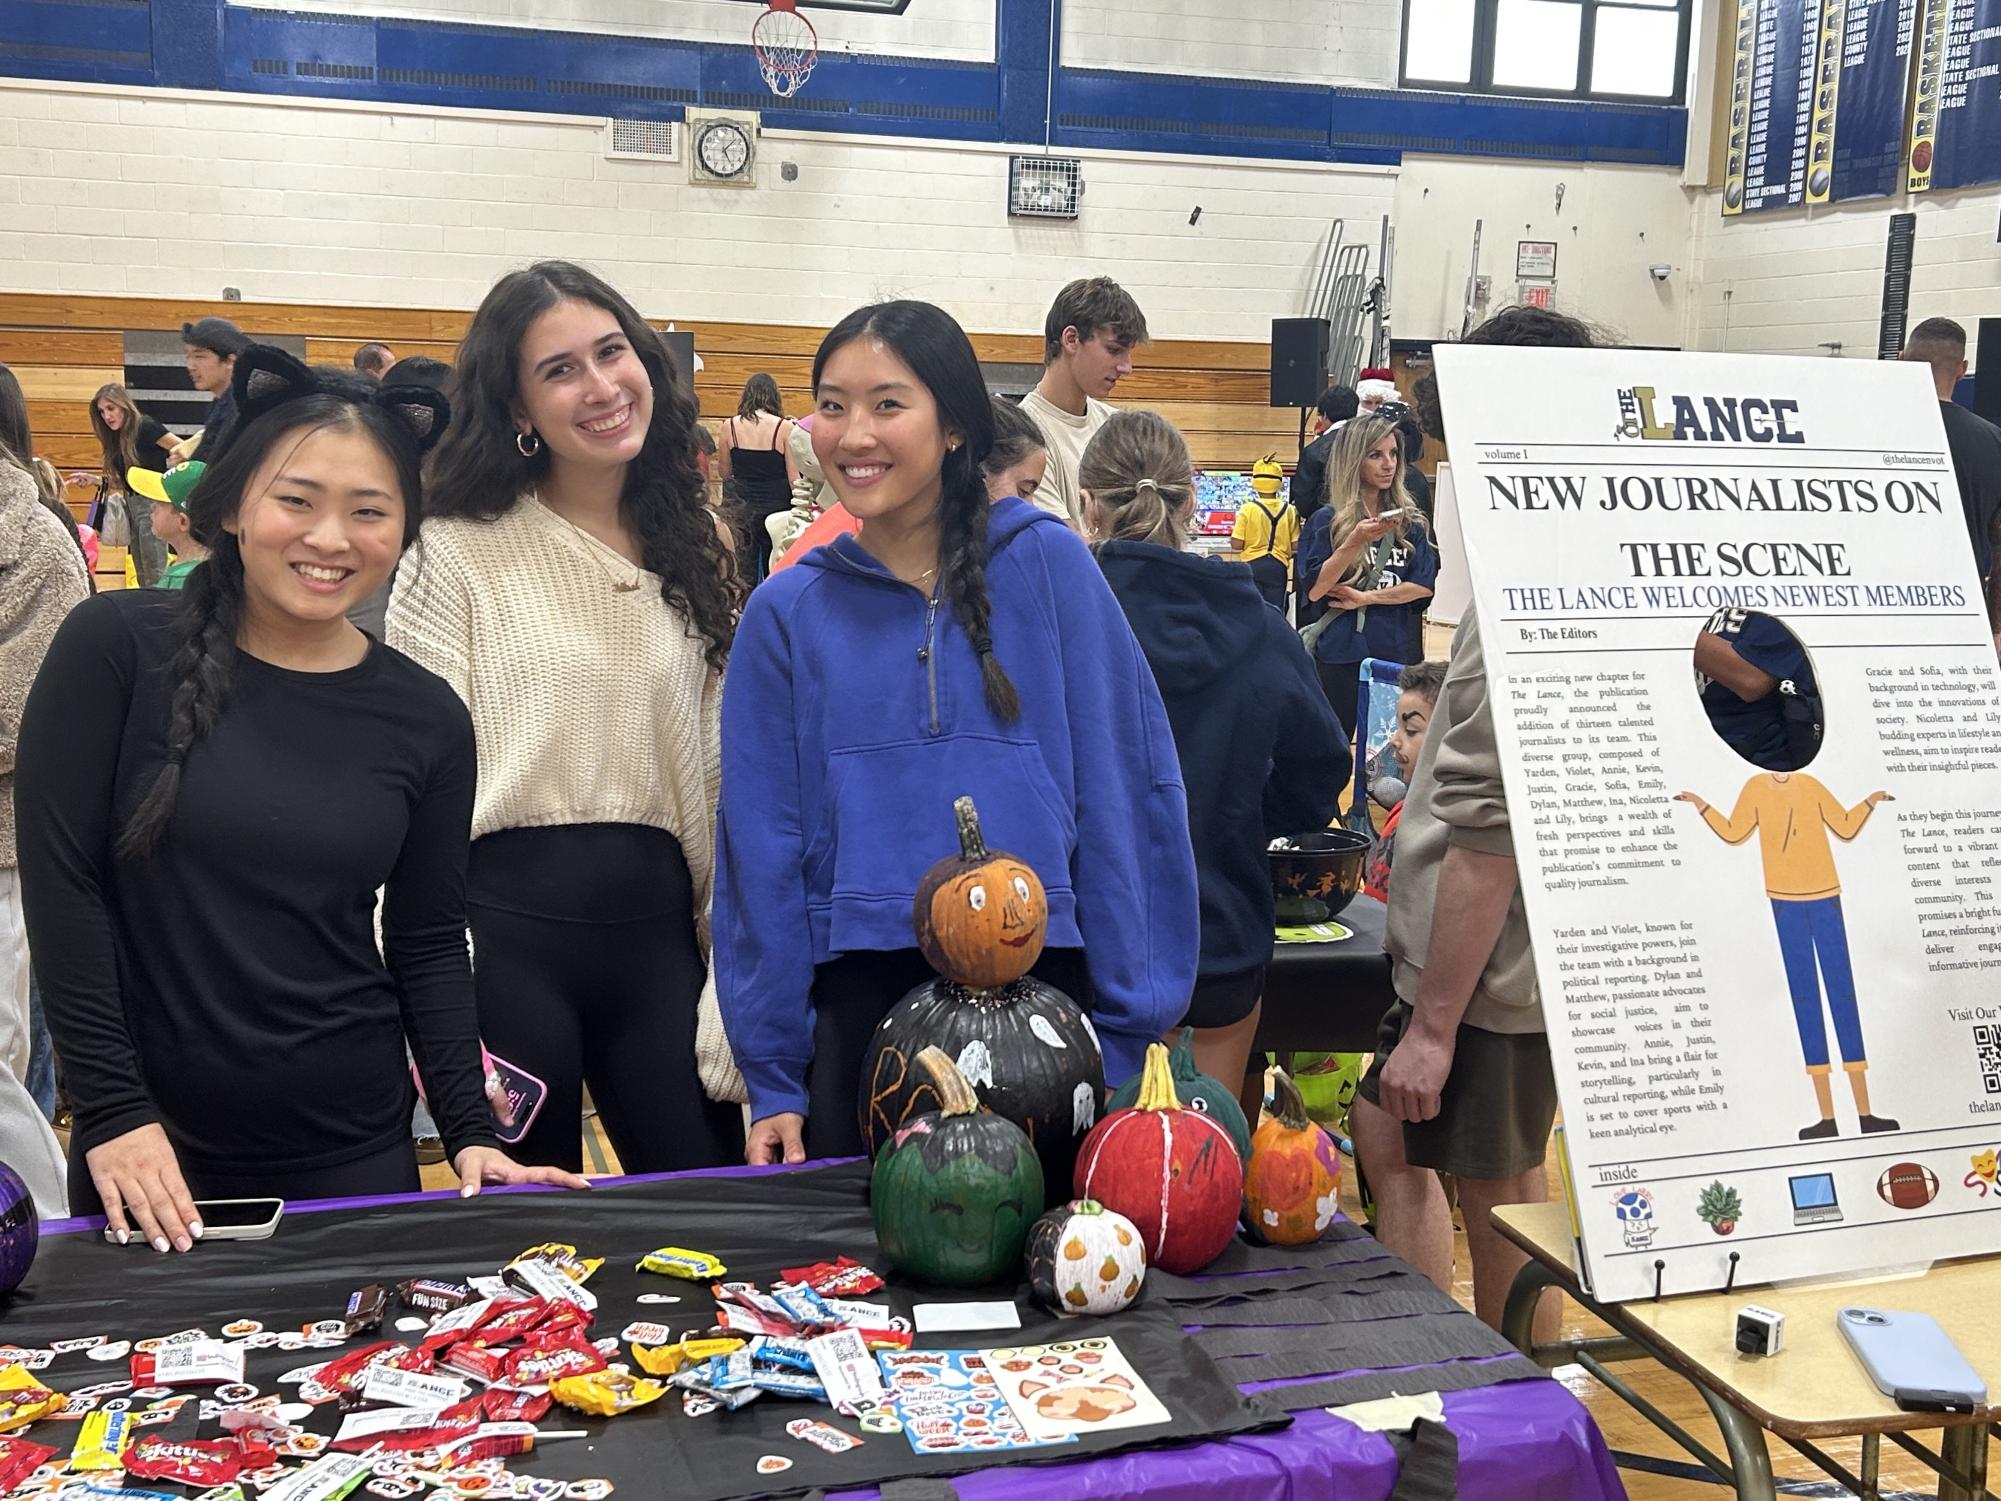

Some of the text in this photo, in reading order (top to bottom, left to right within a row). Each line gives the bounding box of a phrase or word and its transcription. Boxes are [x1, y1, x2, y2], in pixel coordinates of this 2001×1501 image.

[1965, 64, 1999, 80] SECTIONAL
[1617, 387, 1805, 443] THE LANCE
[1484, 449, 1524, 461] volume
[1486, 475, 1944, 515] NEW JOURNALISTS ON
[1620, 542, 1850, 577] THE SCENE
[1503, 586, 1966, 611] THE LANCE WELCOMES NEWEST MEMBERS
[1520, 627, 1597, 641] By: The Editors
[1536, 674, 1571, 684] exciting
[1574, 674, 1592, 682] new
[1597, 672, 1629, 683] chapter
[1633, 672, 1645, 680] for
[1866, 665, 1992, 676] Gracie and Sofia, with their
[1512, 688, 1648, 699] The Lance, the publication
[1868, 681, 1996, 694] background in technology, will
[1514, 703, 1651, 716] proudly announced the
[1873, 697, 1986, 708] dive into the innovations
[1517, 717, 1654, 730] addition of thirteen talented
[1876, 715, 1908, 726] society.
[1916, 714, 1954, 723] Nicoletta
[1962, 713, 1977, 722] and
[1519, 733, 1657, 747] journalists to its team. This
[1522, 748, 1660, 763] diverse group, composed of
[1524, 764, 1663, 778] Yarden, Violet, Annie, Kevin,
[1886, 761, 1998, 773] with their insightful pieces.
[1527, 779, 1666, 795] Justin, Gracie, Sofia, Emily,
[1531, 795, 1669, 810] Dylan, Matthew, Ina, Nicoletta
[1534, 815, 1550, 825] and
[1556, 815, 1575, 825] Lily,
[1579, 813, 1608, 823] brings
[1628, 811, 1657, 820] wealth
[1663, 809, 1672, 818] of
[1897, 810, 1971, 823] As they begin this
[1536, 826, 1675, 842] fresh perspectives and skills
[1901, 825, 1984, 837] The Lance, readers
[1539, 842, 1678, 858] that promise to enhance the
[1542, 860, 1600, 875] publication's
[1608, 859, 1664, 869] commitment
[1545, 876, 1628, 891] quality journalism.
[1553, 921, 1693, 938] Yarden and Violet, known for
[1557, 937, 1696, 954] their investigative powers, join
[1947, 1008, 1974, 1021] Visit
[1975, 1006, 1996, 1019] Our
[1589, 1124, 1677, 1139] keen analytical eye.
[1599, 1165, 1638, 1182] inside
[412, 1293, 448, 1311] FUN SIZE
